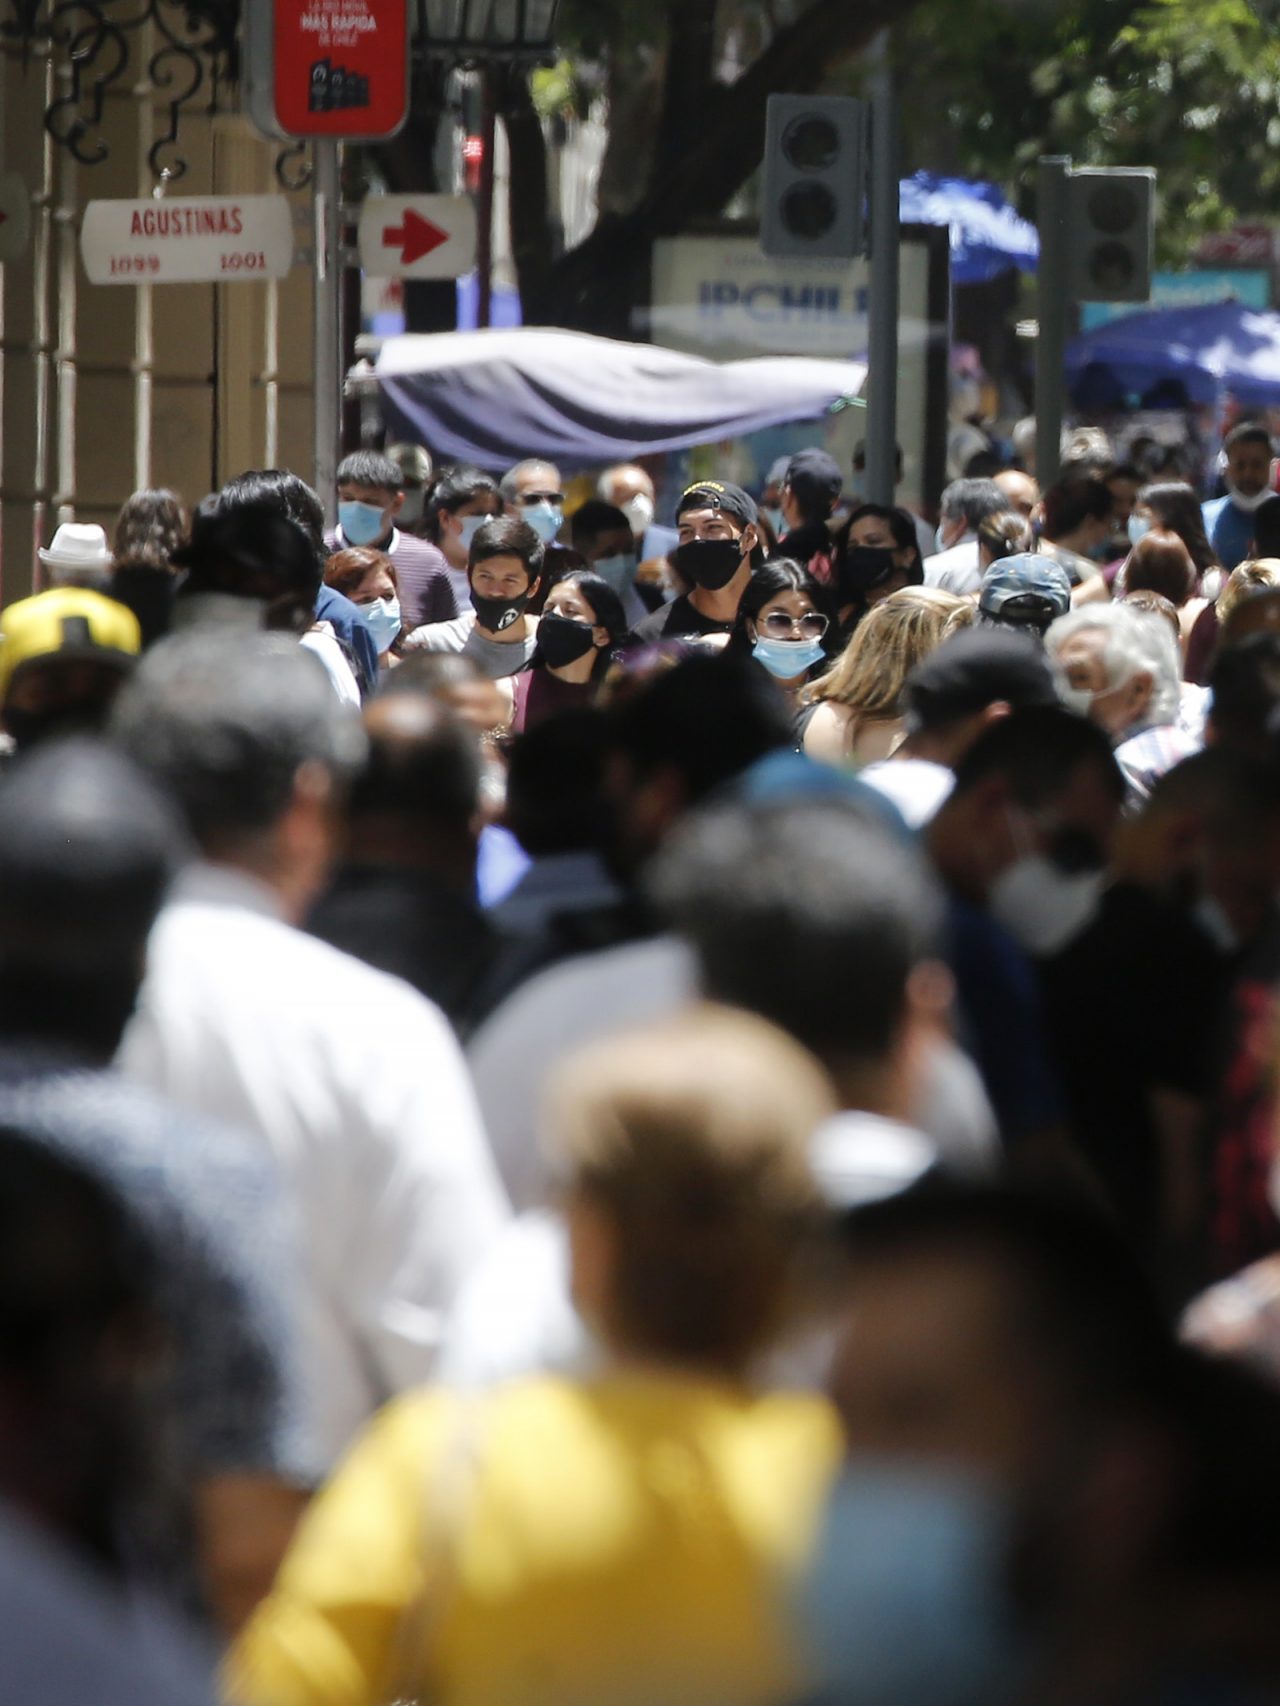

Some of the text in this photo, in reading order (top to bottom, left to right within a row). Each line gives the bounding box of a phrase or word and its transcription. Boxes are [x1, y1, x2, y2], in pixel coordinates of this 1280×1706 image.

[131, 206, 243, 236] AGUSTINAS
[111, 251, 266, 274] 1099 1001
